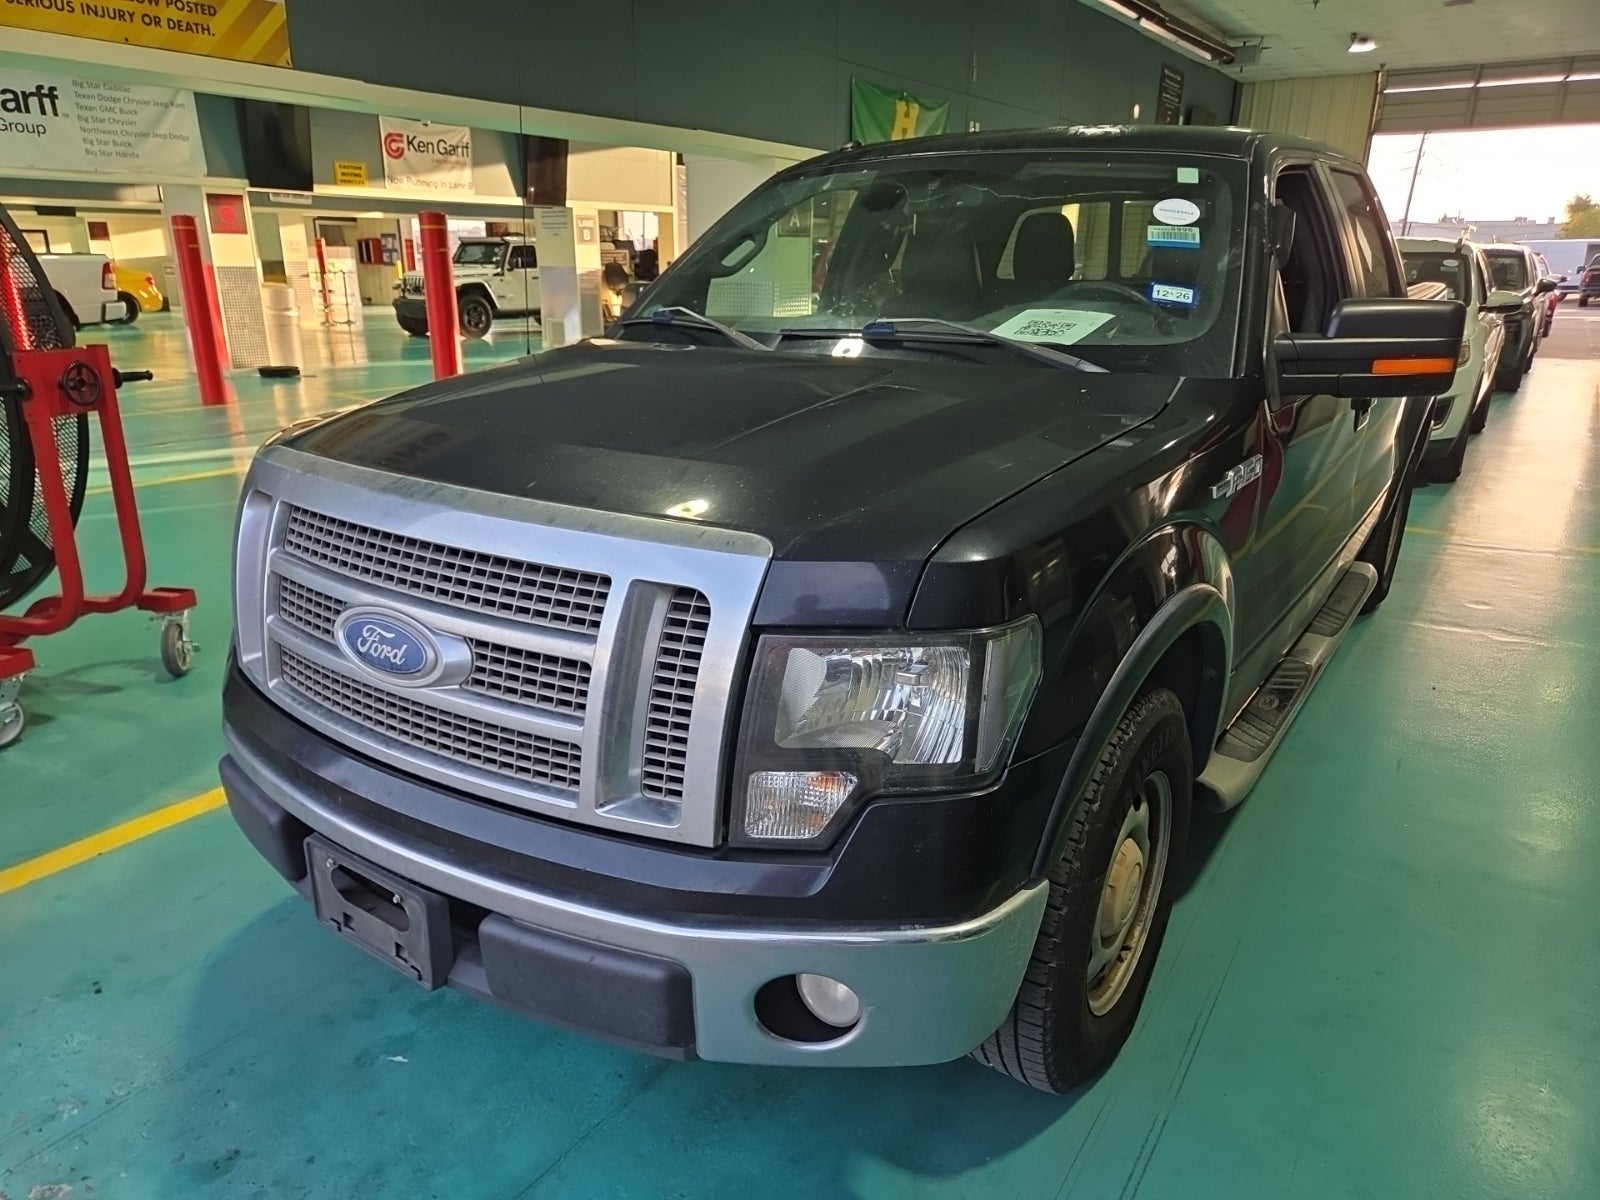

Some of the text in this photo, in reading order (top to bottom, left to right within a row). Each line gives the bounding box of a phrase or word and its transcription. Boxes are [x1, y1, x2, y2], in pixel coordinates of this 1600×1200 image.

[165, 0, 217, 17] POSTED
[80, 3, 136, 23] INJURY
[141, 13, 162, 28] OR
[166, 18, 216, 37] DEATH.
[72, 79, 132, 94] Big Star Cadillac
[0, 84, 59, 117] arff
[74, 91, 96, 101] Texan
[97, 93, 122, 104] Dodge
[122, 96, 151, 107] Chrysler
[152, 99, 169, 110] Jeep
[75, 102, 138, 116] Texan GMC Buick
[77, 114, 137, 127] Big Star Chrysler
[80, 125, 119, 137] Northwest
[120, 129, 151, 139] Chrysler
[82, 136, 132, 148] Big Star Buick
[406, 134, 470, 158] Ken Garff
[98, 149, 113, 158] Star
[357, 624, 407, 665] Ford
